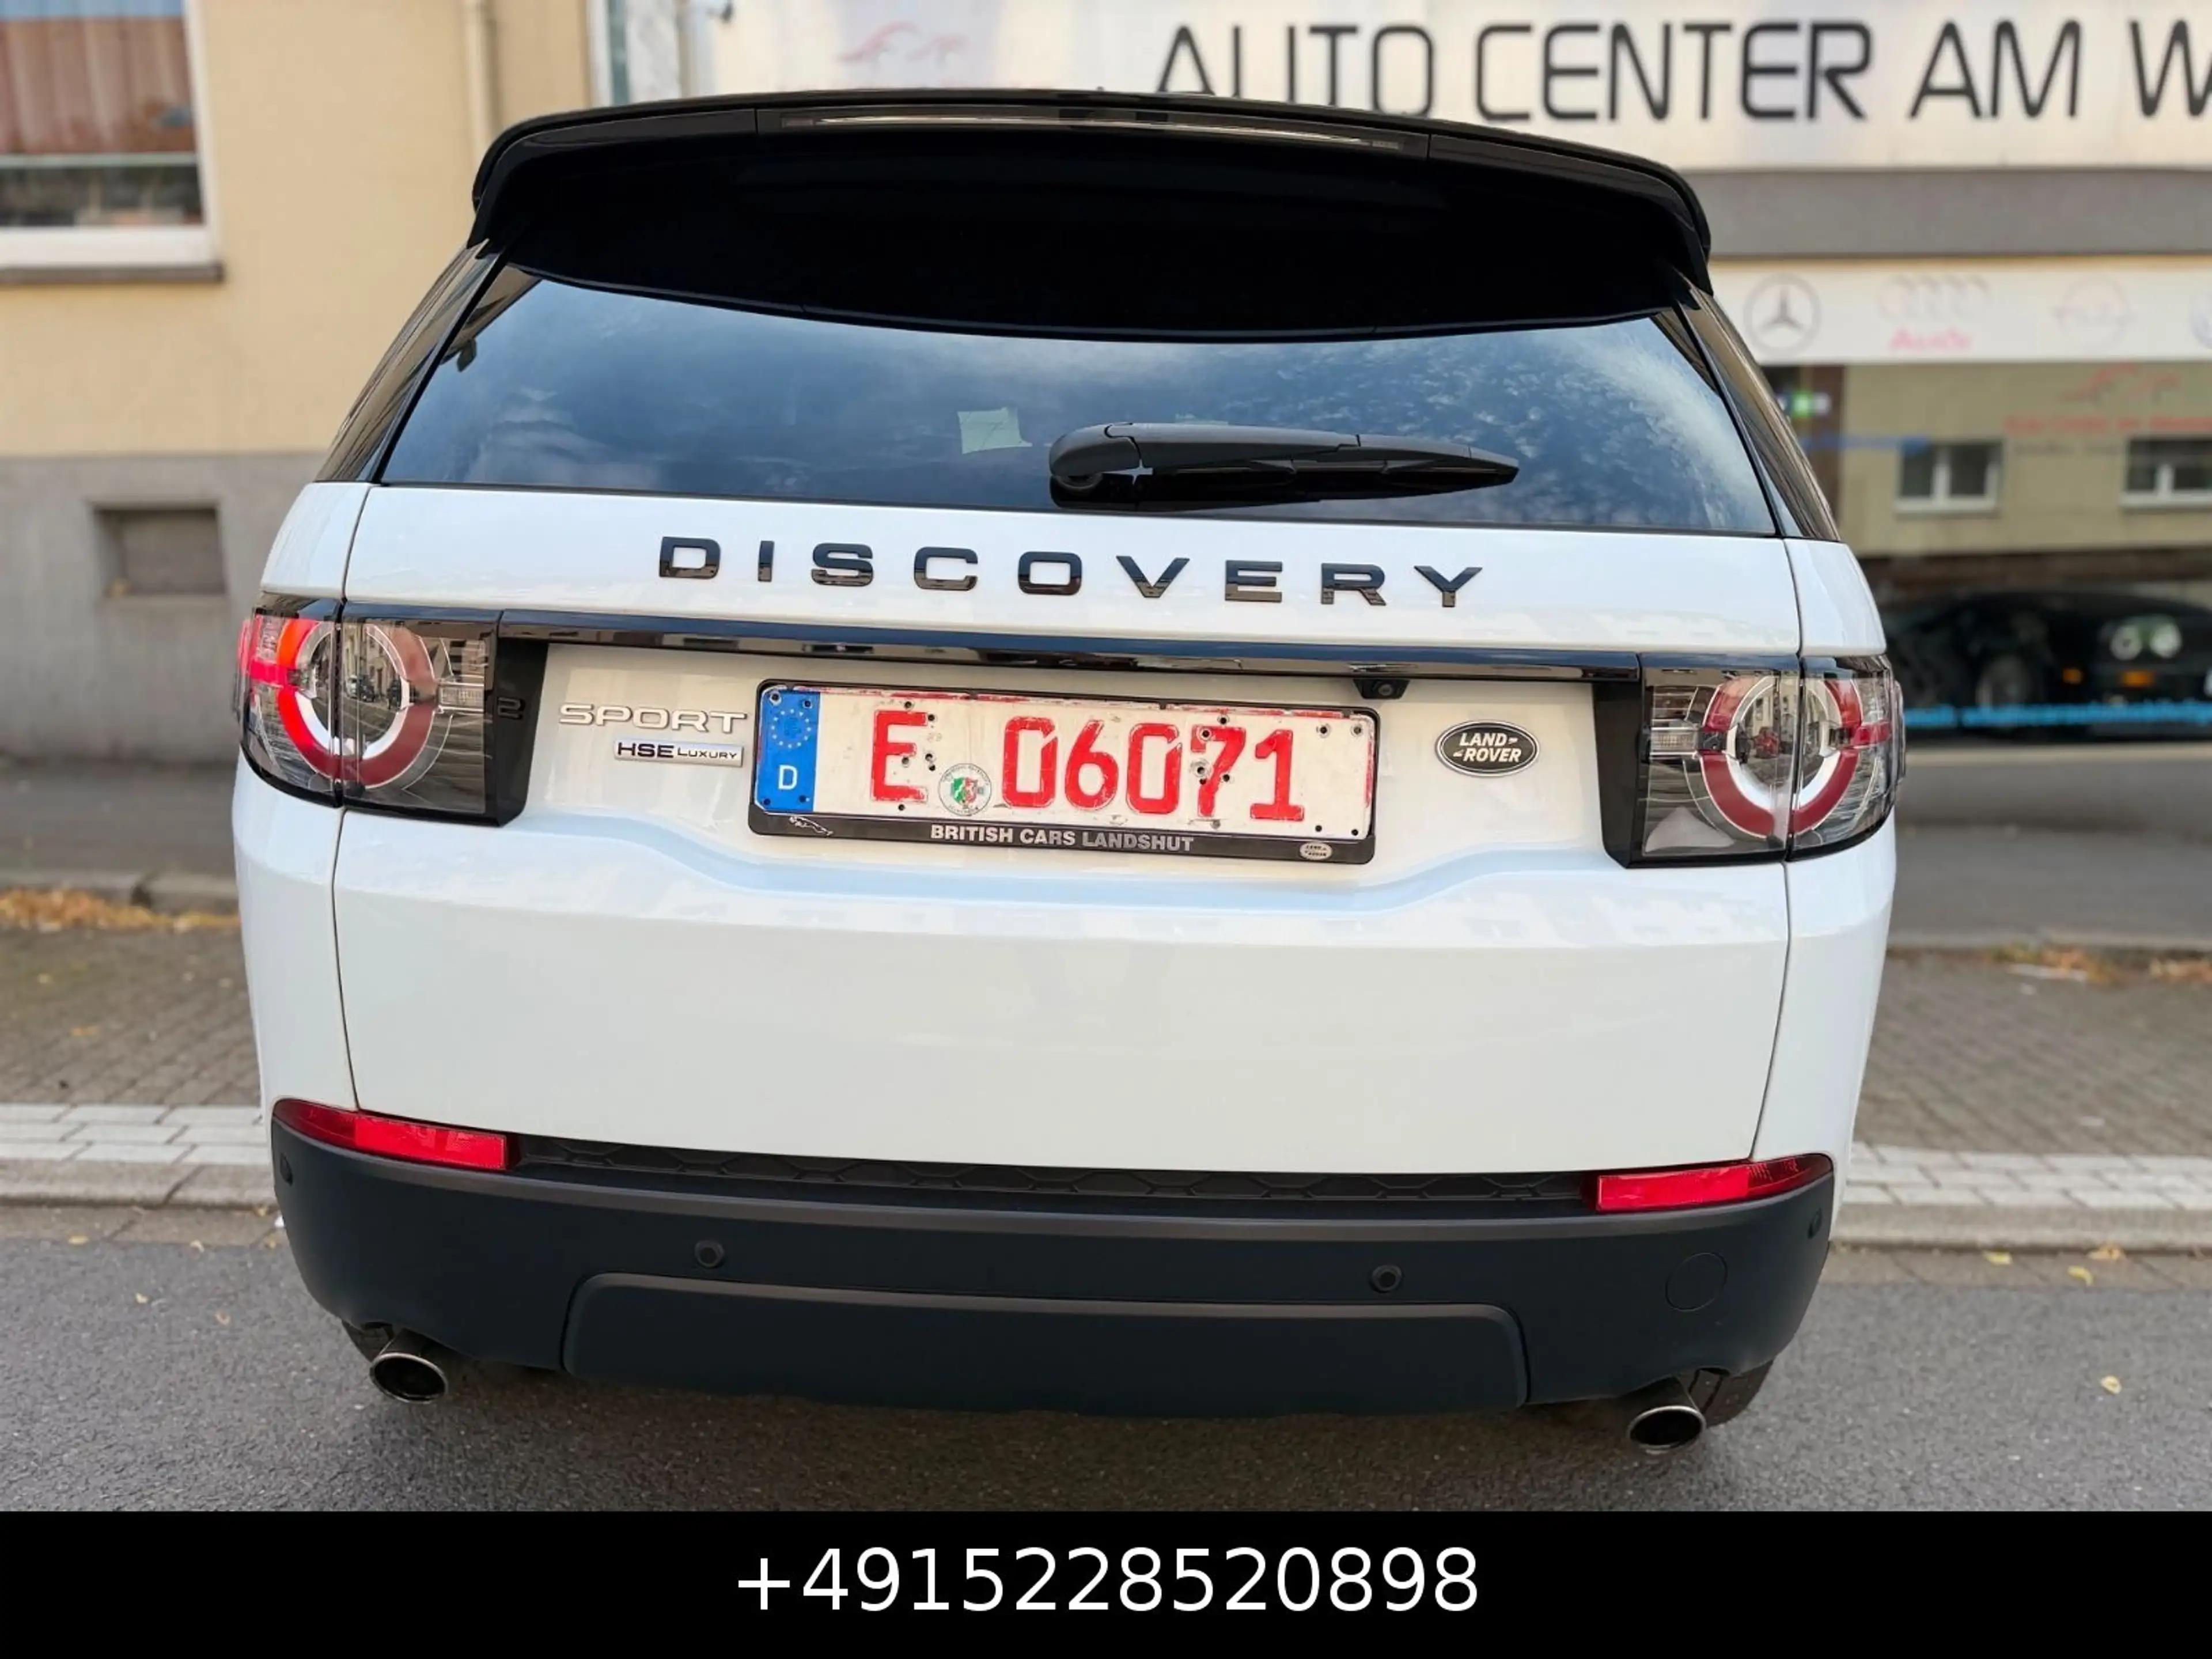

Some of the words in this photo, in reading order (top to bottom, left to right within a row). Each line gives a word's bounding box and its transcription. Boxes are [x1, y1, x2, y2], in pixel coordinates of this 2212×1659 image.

[1156, 24, 1434, 118] AUTO
[1475, 19, 1872, 121] CENTER
[1908, 19, 2082, 120] AM
[658, 536, 1484, 608] DISCOVERY
[559, 703, 748, 734] SPORT
[617, 741, 675, 759] HSE
[677, 747, 738, 761] LUXURY
[1460, 733, 1508, 747] LAND
[871, 710, 929, 803] E
[1001, 716, 1305, 822] 06071
[1463, 748, 1522, 762] ROVER
[778, 765, 798, 791] D
[930, 824, 1013, 843] BRITISH
[1020, 829, 1076, 847] CARS
[1082, 832, 1194, 853] LANDSHUT
